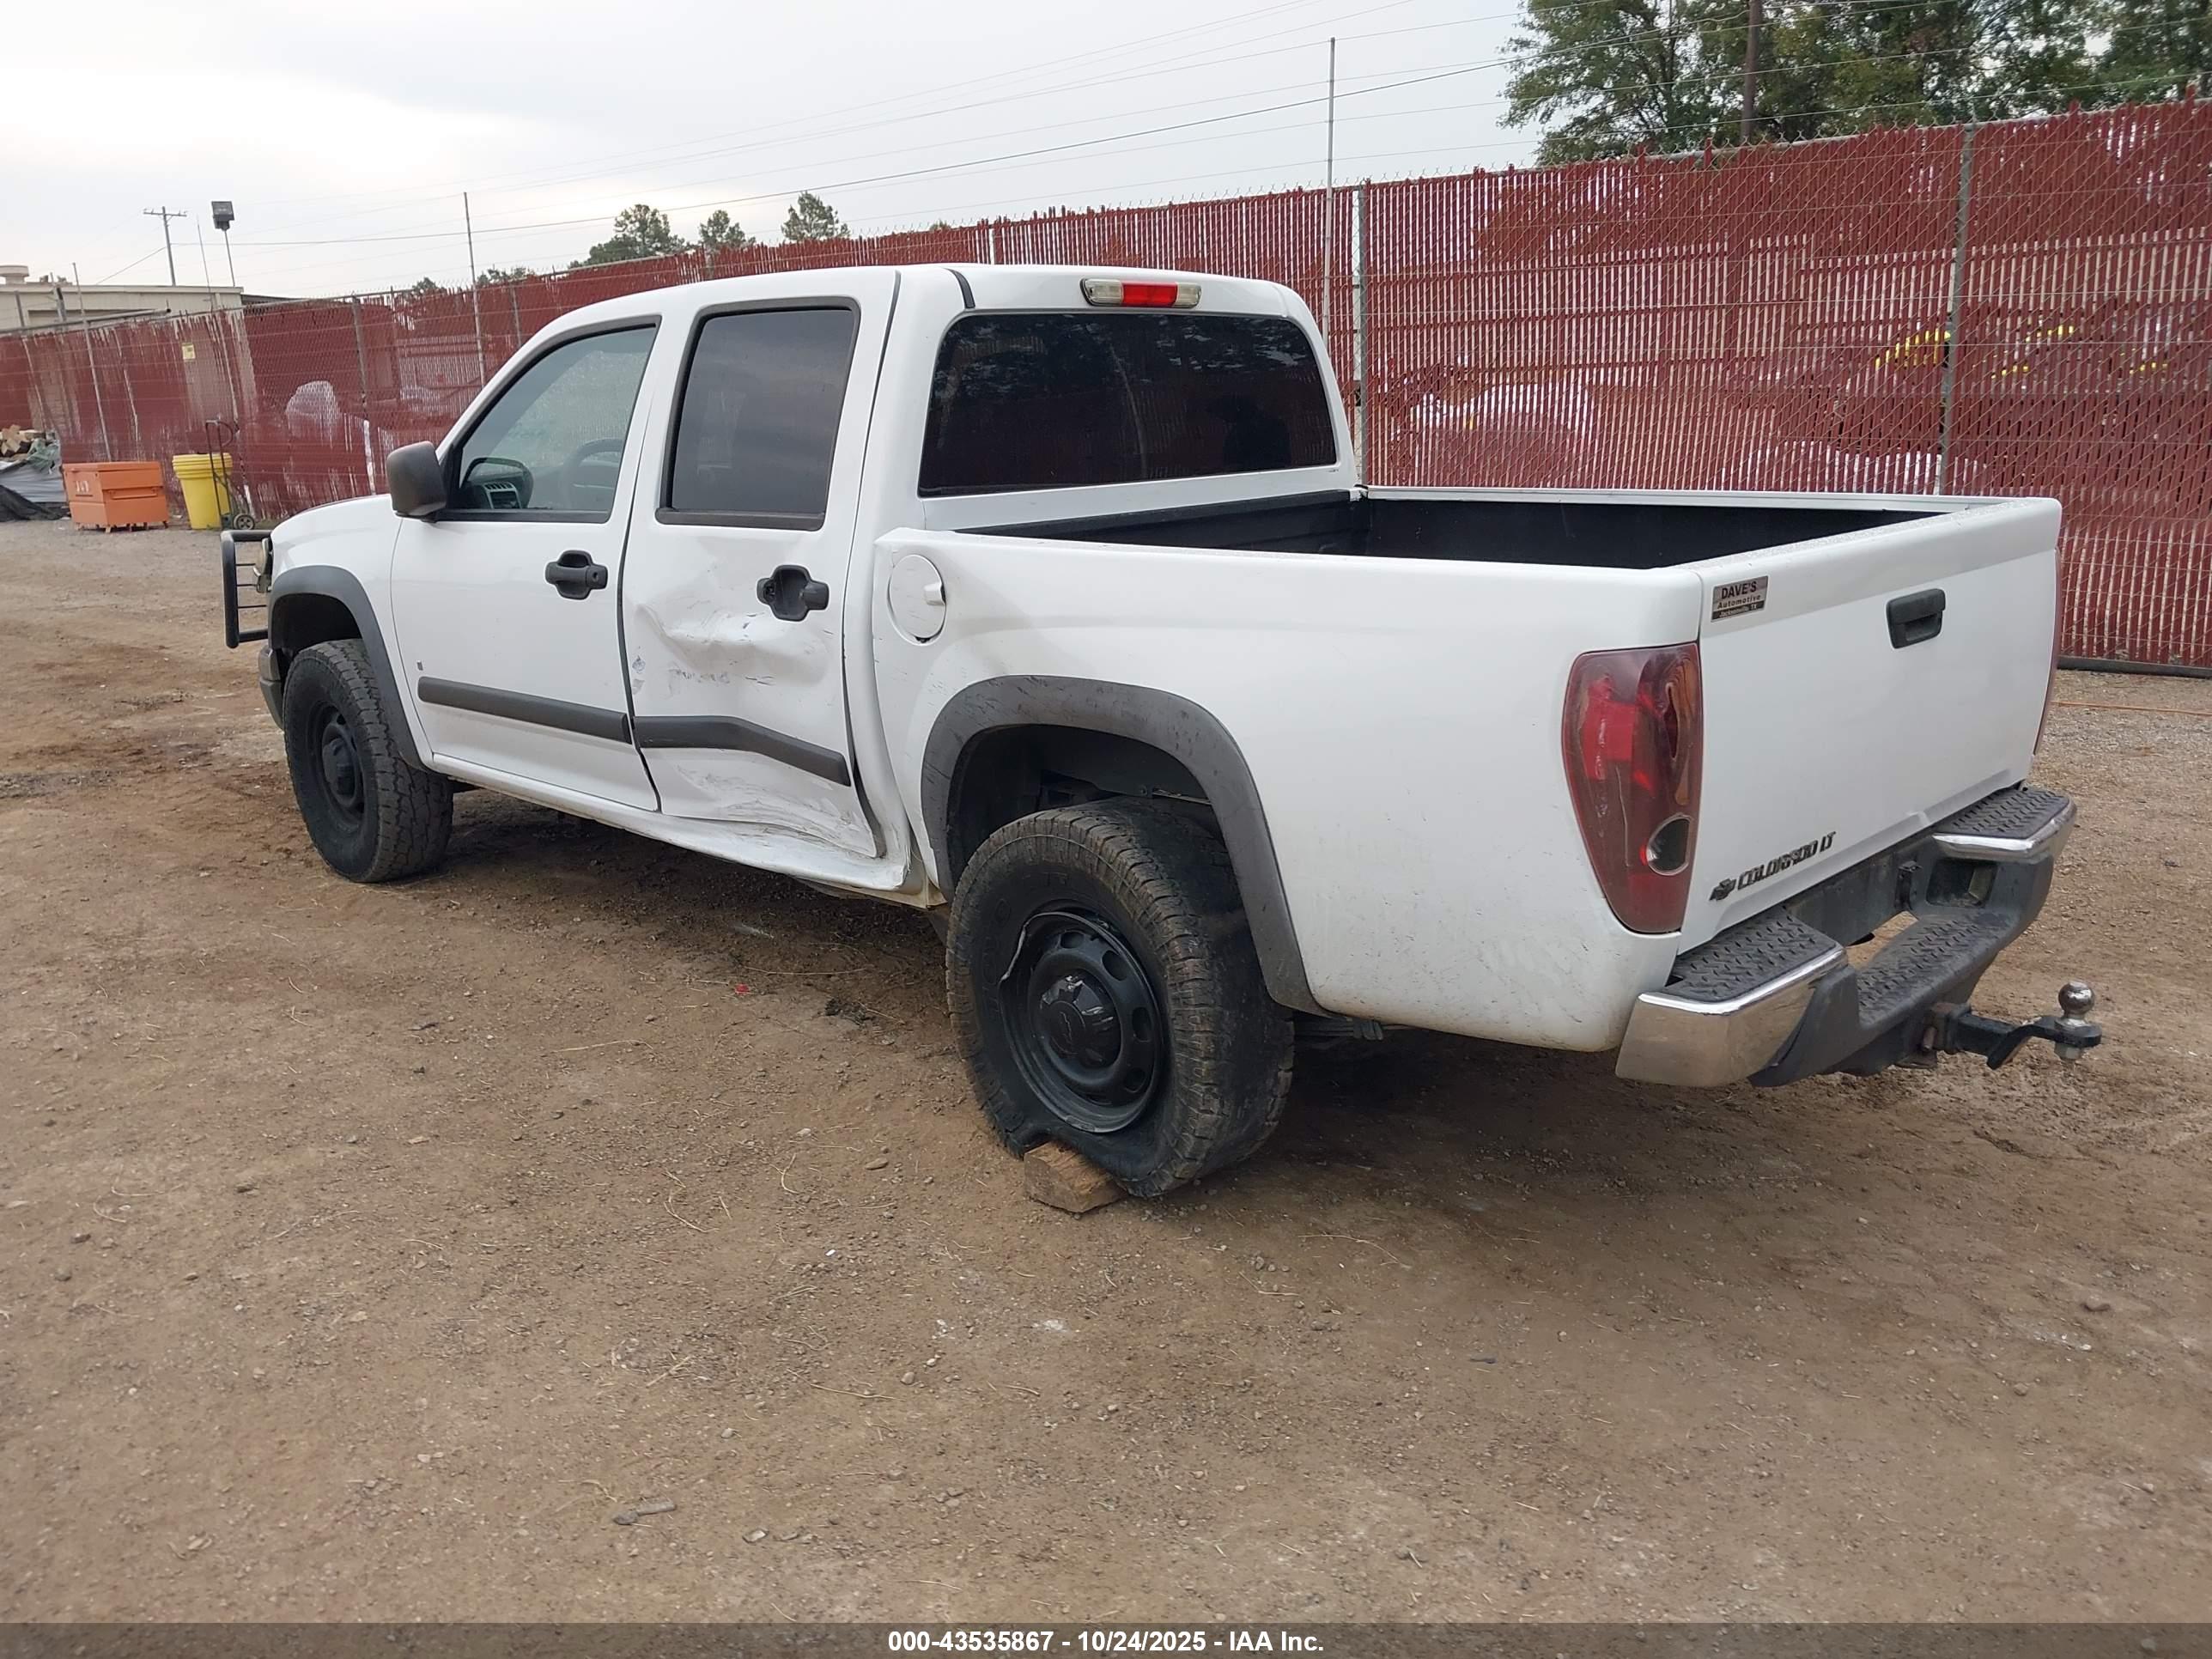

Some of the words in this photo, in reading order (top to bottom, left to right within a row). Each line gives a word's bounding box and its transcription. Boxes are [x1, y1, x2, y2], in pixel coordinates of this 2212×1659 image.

[1721, 580, 1757, 599] DAVE'S
[1717, 594, 1760, 610] Automotive
[1737, 840, 1818, 890] COLORADO
[1820, 831, 1836, 853] LT
